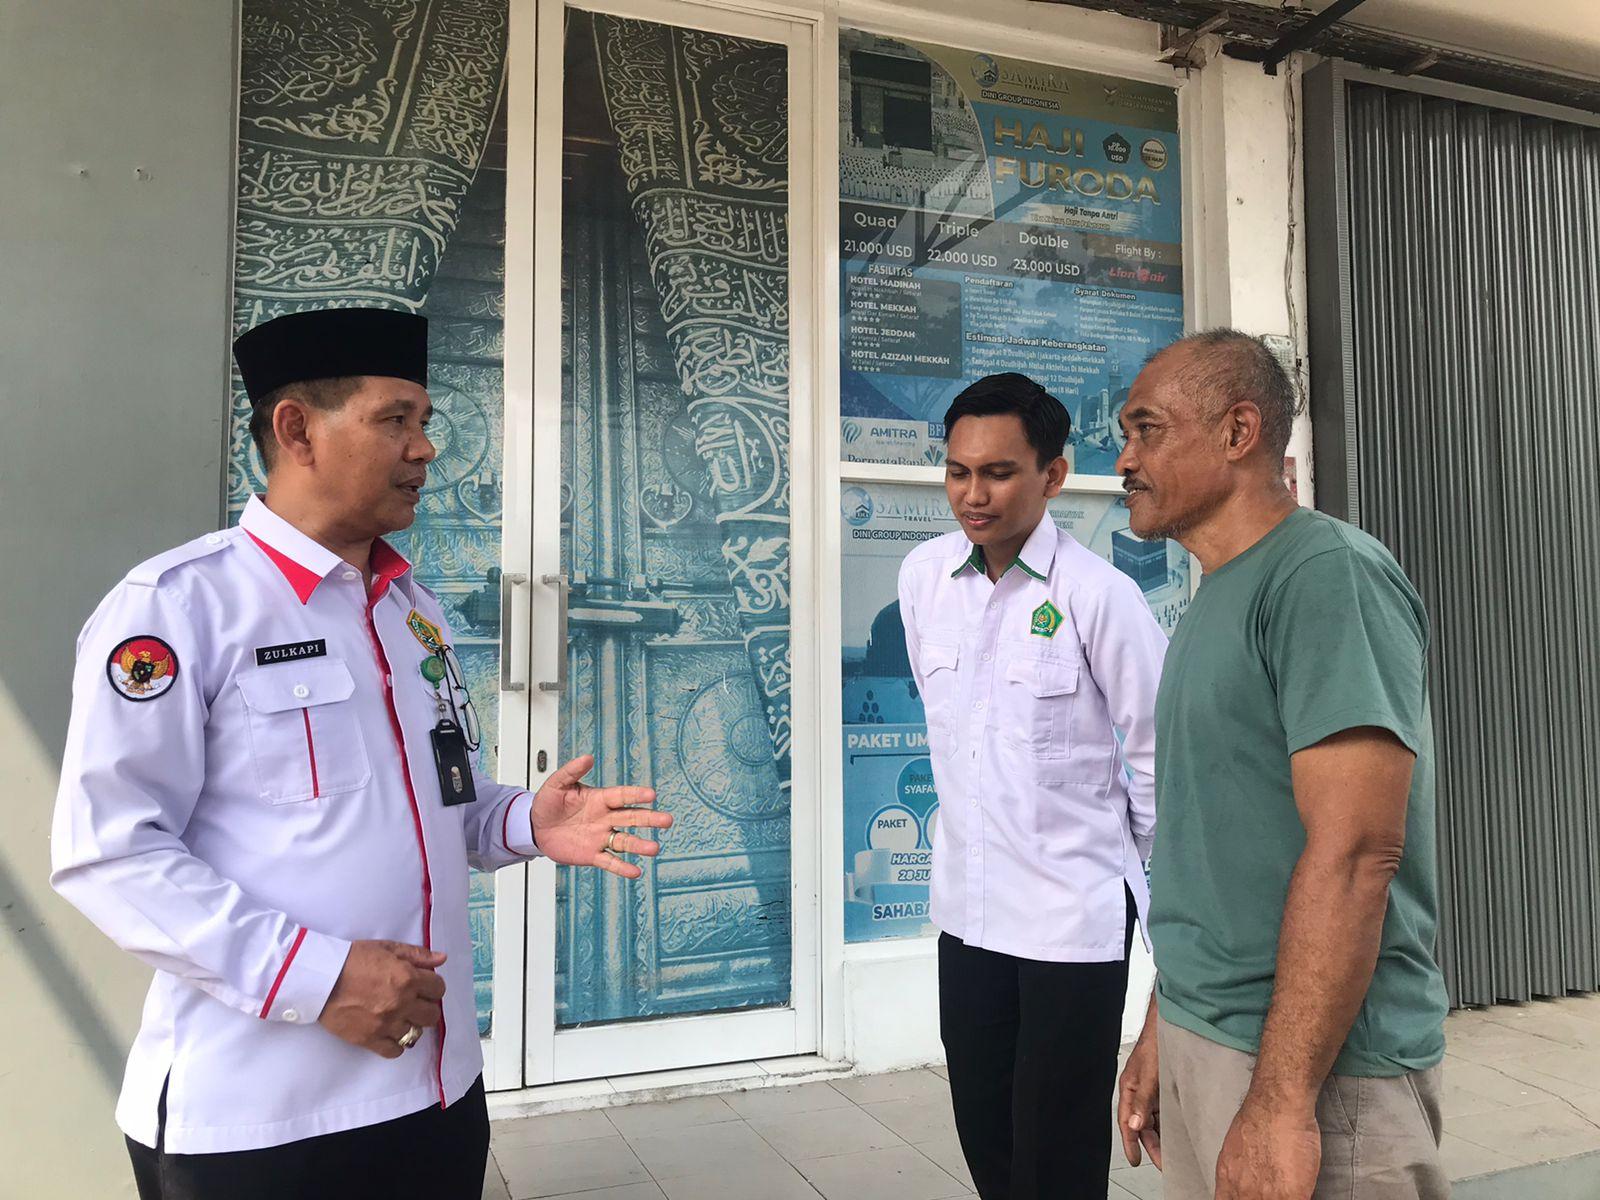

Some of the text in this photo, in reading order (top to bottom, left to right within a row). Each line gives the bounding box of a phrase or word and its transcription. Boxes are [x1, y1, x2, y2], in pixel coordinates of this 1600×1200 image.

[1001, 68, 1070, 91] SAMIRA
[998, 92, 1021, 105] GROUP
[1021, 97, 1061, 110] INDONESIA
[993, 115, 1085, 158] HAJI
[995, 154, 1161, 205] FURODA
[853, 211, 897, 228] Quad
[1064, 206, 1119, 220] Haji Tanpa Antri
[937, 221, 980, 238] Triple
[1019, 231, 1070, 249] Double
[844, 239, 913, 258] 21.000 USD
[1115, 243, 1142, 257] Flight
[1144, 249, 1157, 260] By
[927, 248, 998, 267] 22.000 USD
[868, 264, 913, 278] FASILITAS
[1013, 258, 1081, 276] 23.000 USD
[1109, 267, 1136, 280] Lion
[850, 276, 878, 286] HOTEL
[880, 278, 921, 290] MADINAH
[964, 275, 1014, 288] Pendaftaran
[1074, 287, 1136, 300] Syarat Dokumen
[850, 300, 917, 313] HOTEL MEKKAH
[850, 326, 916, 338] HOTEL JEDDAH
[965, 332, 1107, 352] Estimasi Jadwal Keberangkatan
[850, 350, 950, 365] HOTEL AZIZAH MEKKAH
[870, 427, 918, 439] AMITRA
[904, 515, 932, 523] TRAVEL
[852, 528, 871, 540] DINI
[871, 529, 900, 541] GROUP
[263, 644, 320, 660] ZULKAPI
[847, 733, 901, 749] PAKET
[877, 818, 908, 829] PAKET
[898, 869, 913, 881] 28
